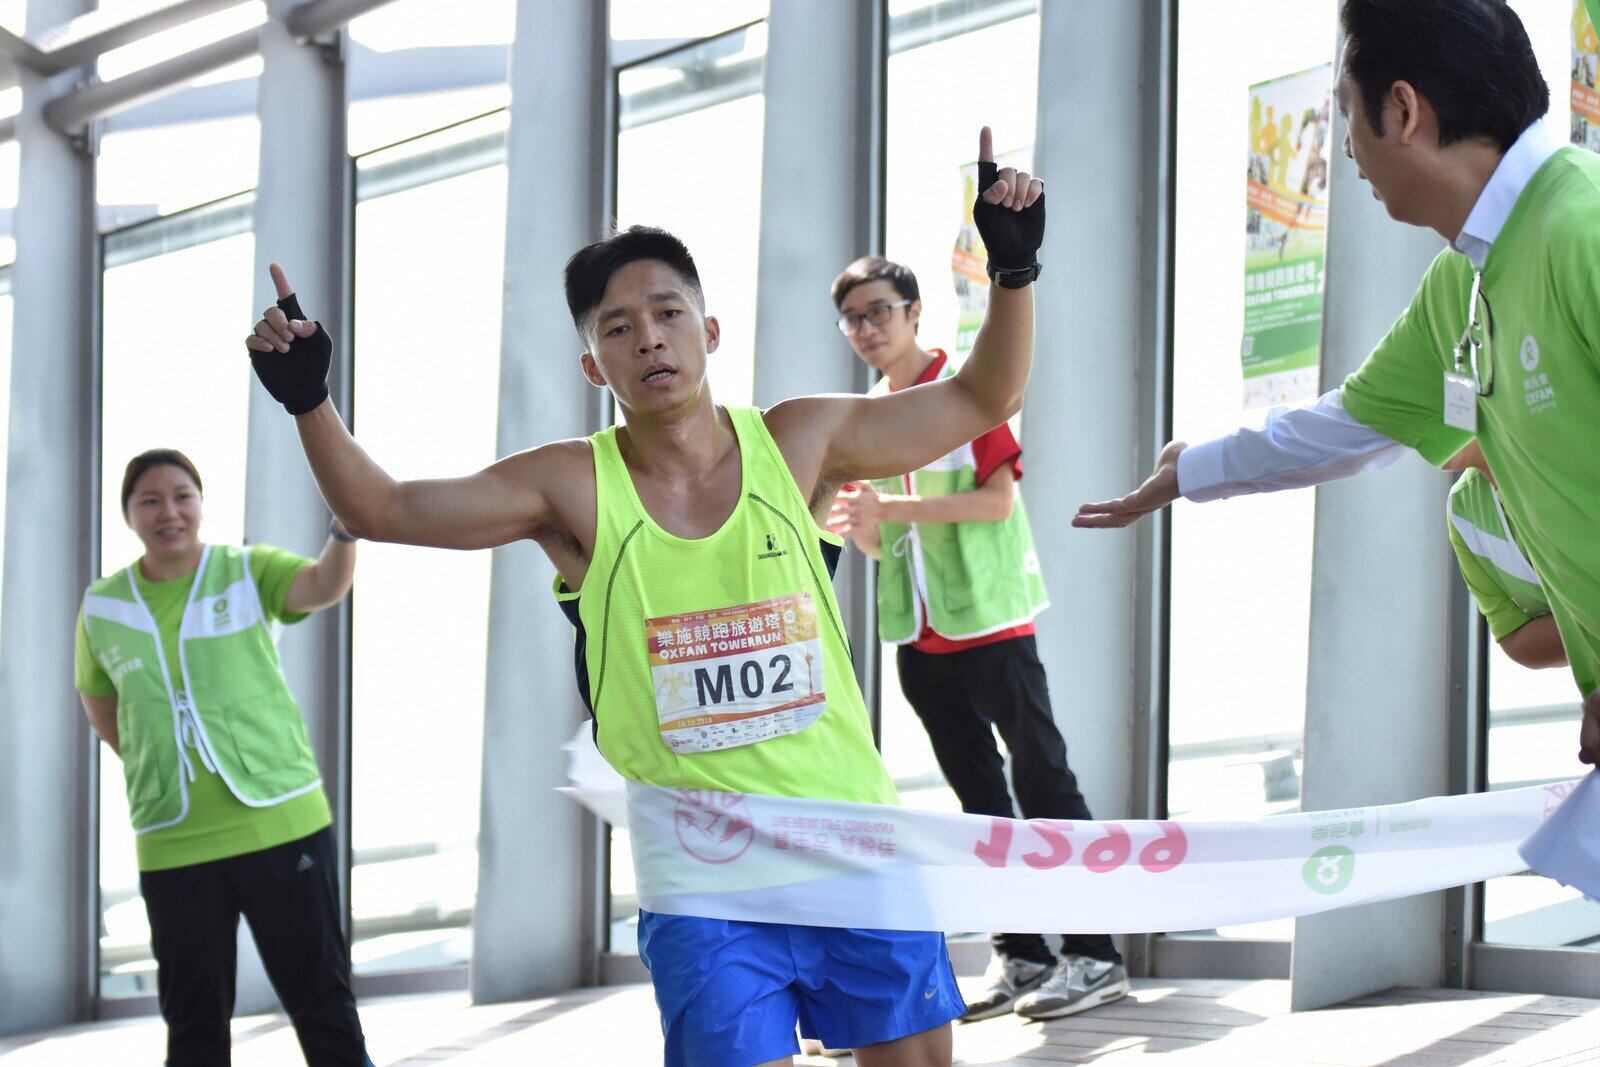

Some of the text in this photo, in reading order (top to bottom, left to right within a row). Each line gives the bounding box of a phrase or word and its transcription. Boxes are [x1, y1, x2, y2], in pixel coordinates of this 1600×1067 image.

[657, 612, 781, 648] 樂施競跑旅遊塔
[659, 631, 782, 660] OXFAM TOWERRUN
[694, 654, 794, 706] M02
